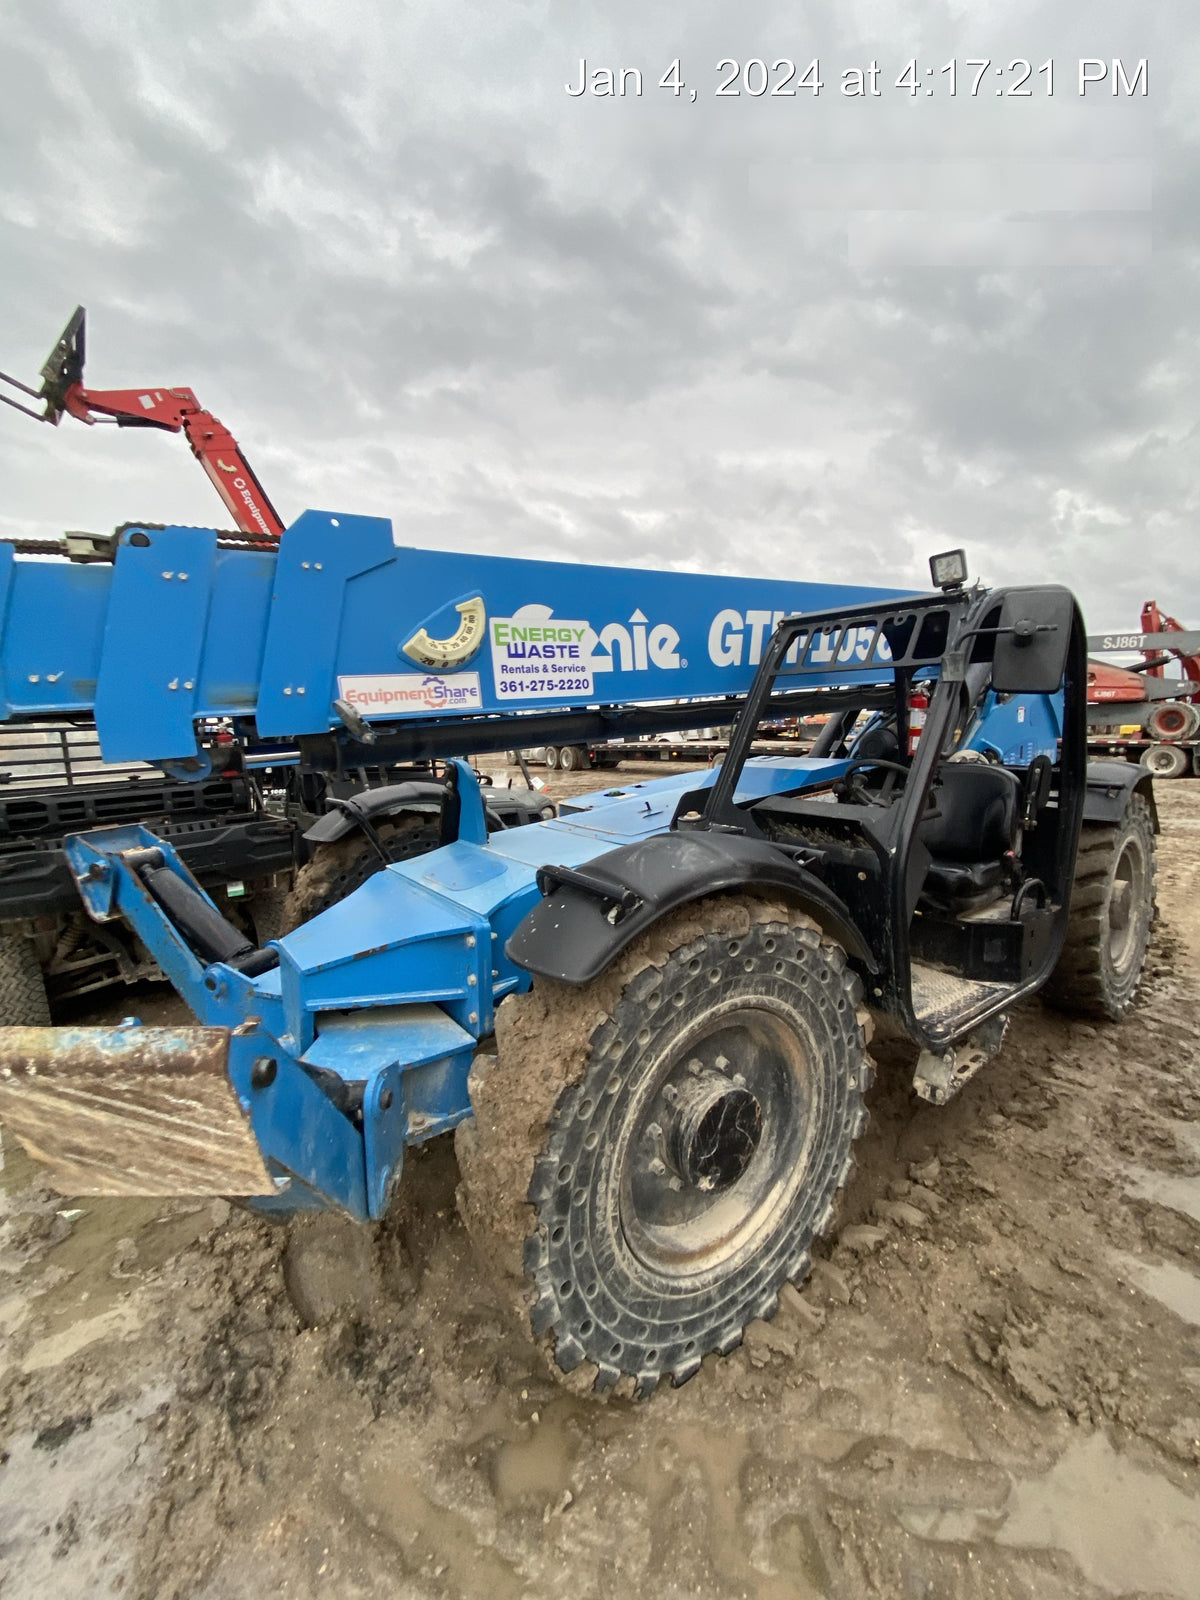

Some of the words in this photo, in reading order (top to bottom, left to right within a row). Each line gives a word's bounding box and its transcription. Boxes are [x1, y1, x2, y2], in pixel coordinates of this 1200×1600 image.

[240, 489, 272, 536] Equipme
[494, 623, 586, 647] ENERGY
[1102, 635, 1147, 649] SJ86T
[507, 642, 580, 658] WASTE
[501, 664, 540, 674] Rentals
[542, 664, 549, 673] &
[551, 664, 586, 673] Service
[500, 678, 590, 693] 361-275-2220
